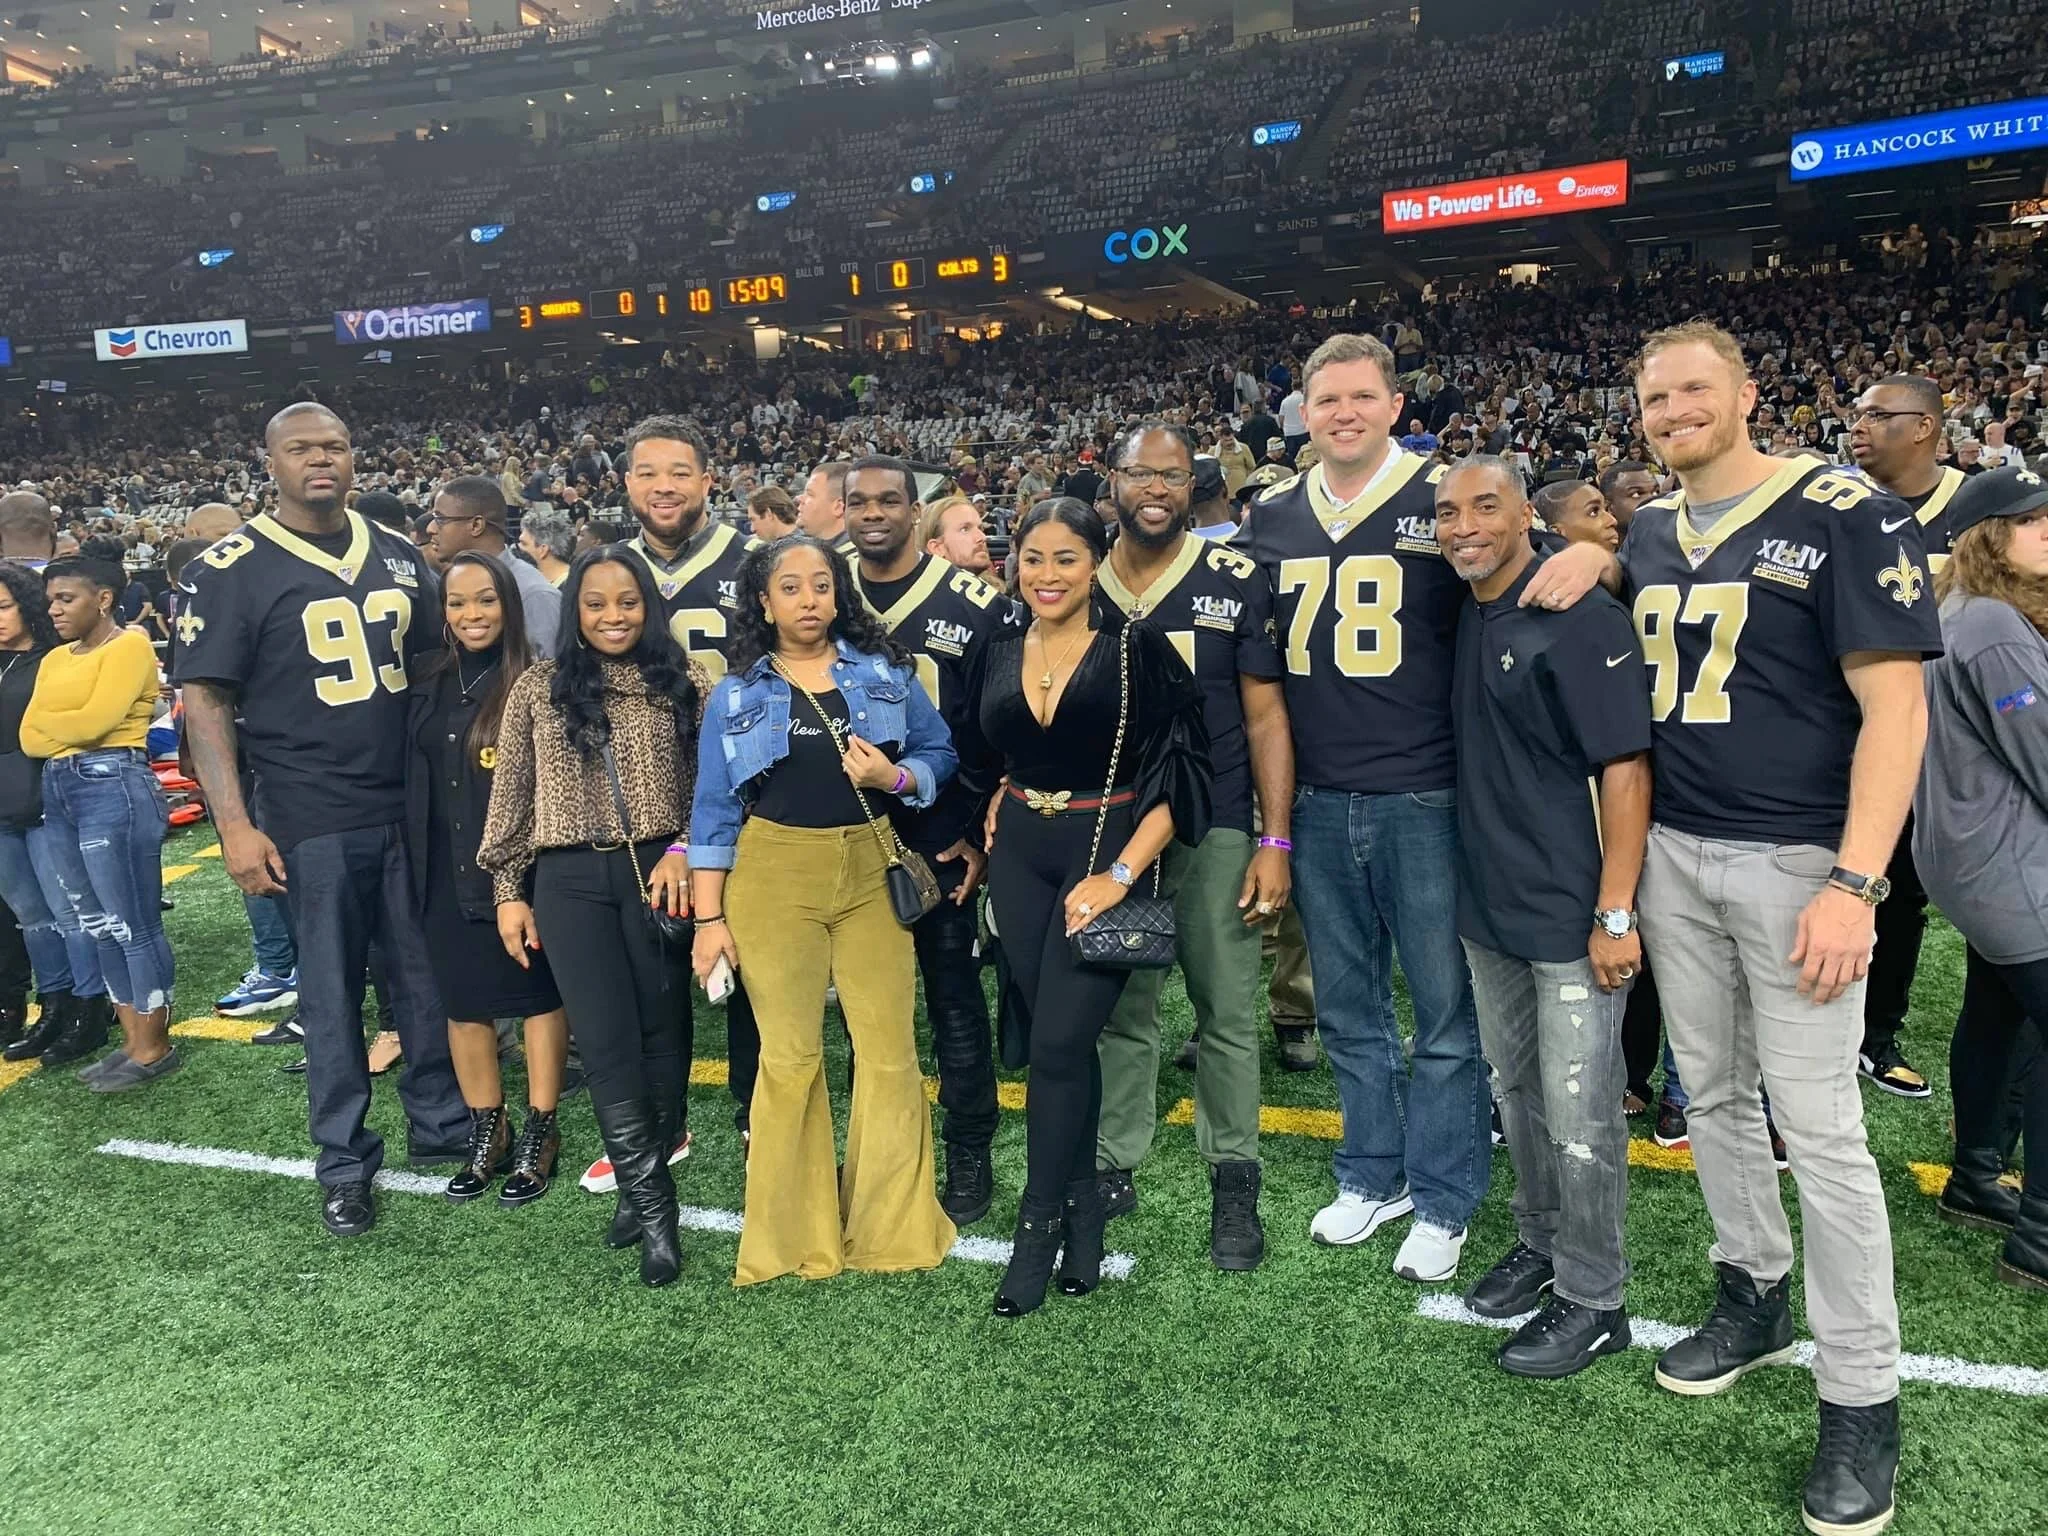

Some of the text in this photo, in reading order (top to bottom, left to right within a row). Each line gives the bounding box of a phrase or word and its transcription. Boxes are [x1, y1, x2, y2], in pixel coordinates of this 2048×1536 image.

[756, 0, 880, 30] Mercedes-Benz
[1833, 127, 1956, 160] HANCOCK
[1967, 113, 2048, 140] WHIT
[1686, 160, 1737, 178] SAINTS
[1575, 183, 1619, 198] Entergy
[1392, 184, 1543, 222] We Power Life.
[1277, 217, 1318, 232] SAINTS
[1104, 224, 1189, 264] COX
[840, 262, 859, 273] QTR
[892, 261, 908, 288] 0
[937, 258, 979, 277] COLTS
[993, 255, 1007, 281] 3
[728, 276, 784, 303] 15:09
[851, 274, 859, 296] 1
[619, 291, 633, 314] 0
[658, 294, 666, 315] 1
[689, 288, 711, 313] 10
[365, 307, 477, 341] Ochsner
[519, 305, 532, 328] 3
[144, 330, 232, 351] Chevron
[1756, 538, 1828, 570] XLIV
[1762, 562, 1806, 579] CHAMPIONS
[1191, 596, 1243, 617] XLIV
[1278, 554, 1404, 677] 78
[924, 618, 974, 643] XLIV
[301, 588, 412, 706] 93
[1632, 581, 1750, 723] 97
[787, 718, 823, 736] New
[479, 747, 497, 769] 9
